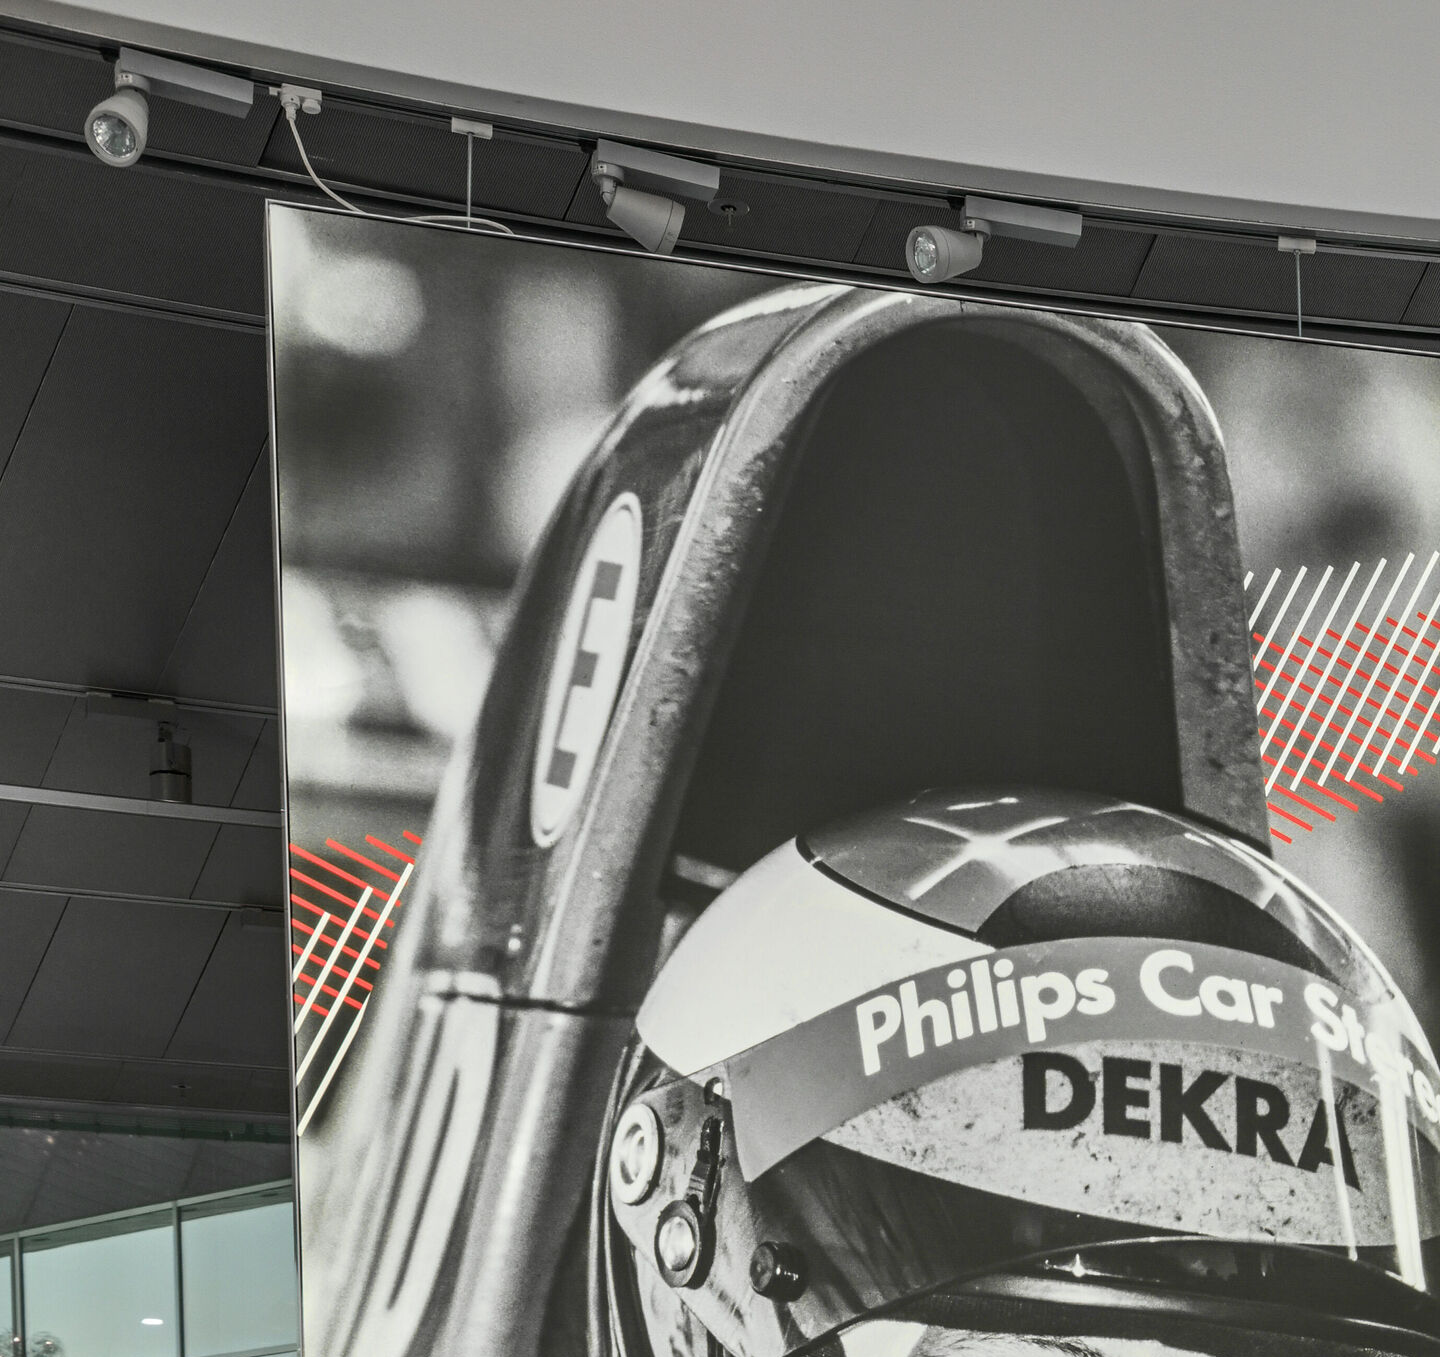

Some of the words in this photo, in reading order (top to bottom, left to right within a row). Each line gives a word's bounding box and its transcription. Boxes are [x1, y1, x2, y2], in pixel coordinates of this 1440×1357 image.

[856, 957, 1116, 1075] Philips
[1140, 949, 1284, 1029] Car
[1021, 1051, 1363, 1193] DEKRA
